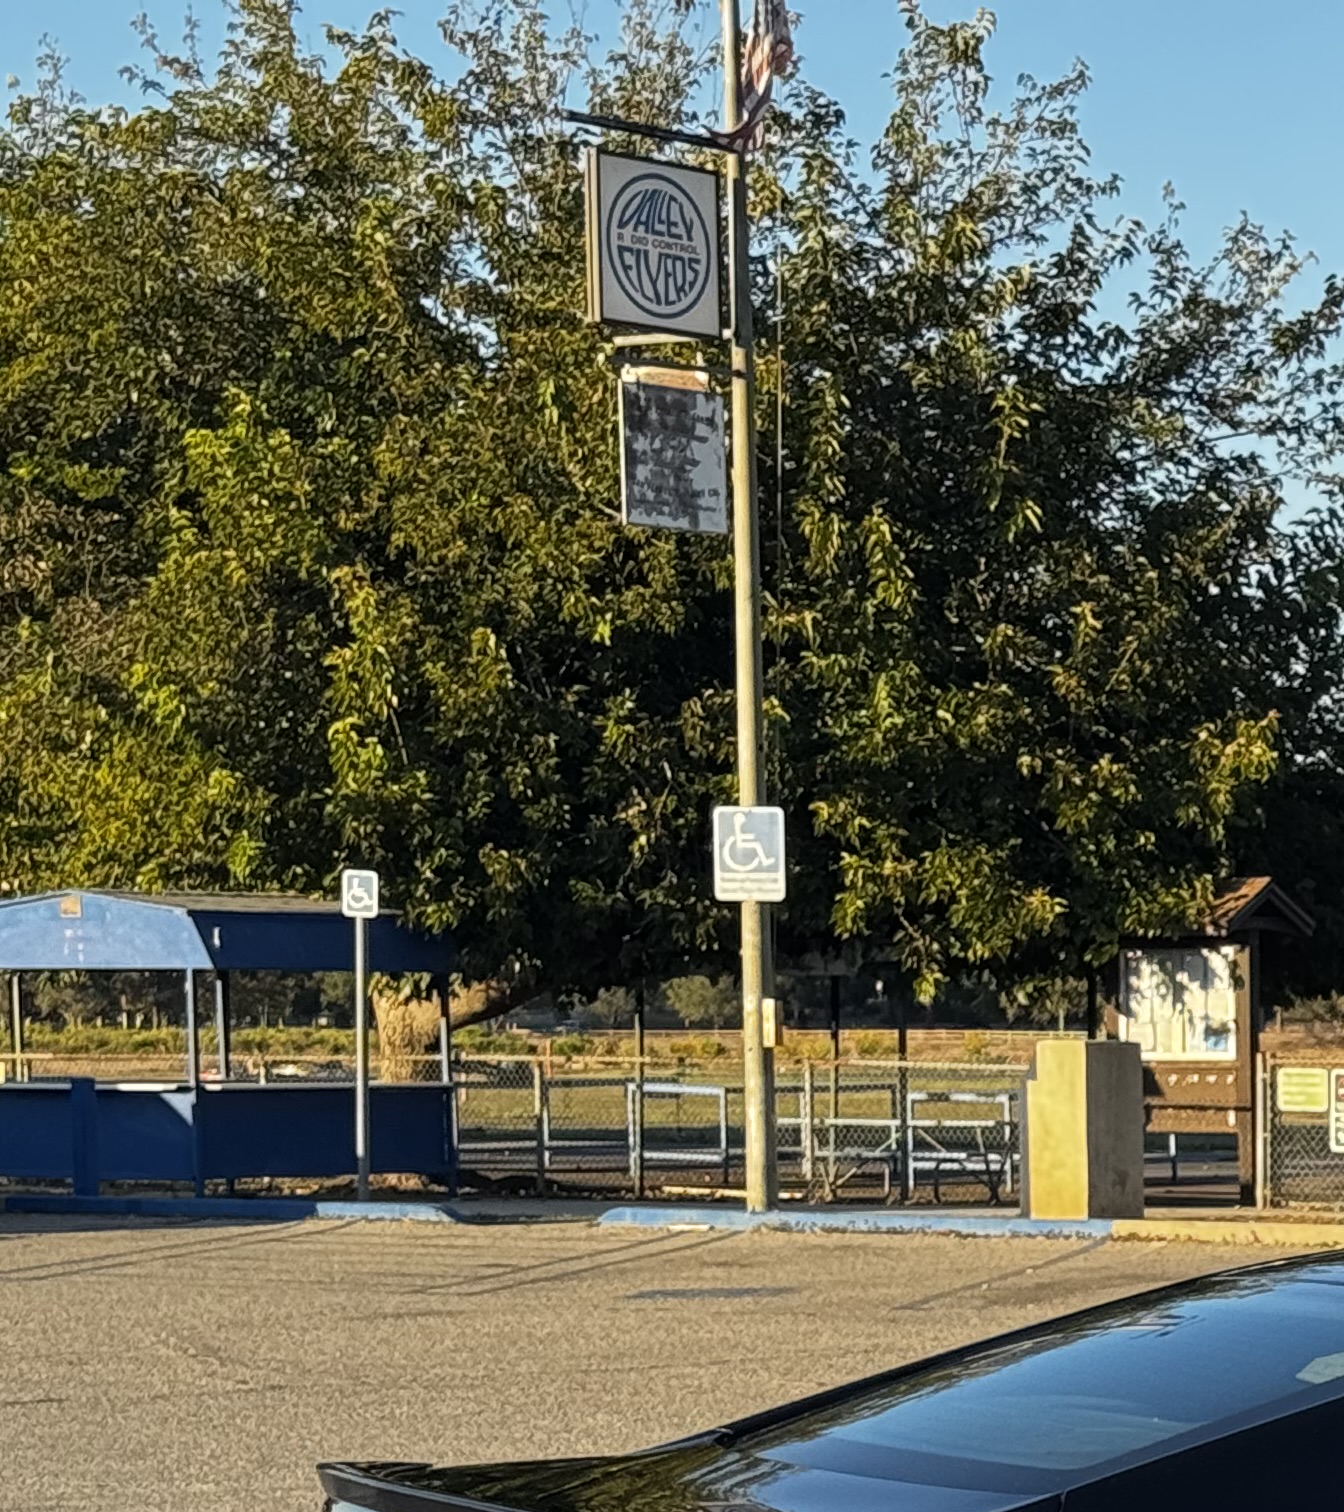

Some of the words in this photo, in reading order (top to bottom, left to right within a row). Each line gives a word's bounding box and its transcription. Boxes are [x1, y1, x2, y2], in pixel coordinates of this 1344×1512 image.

[617, 188, 694, 242] VALLEY
[616, 231, 649, 247] RDIO
[651, 238, 701, 256] CONTROL
[617, 244, 702, 307] FLYERS
